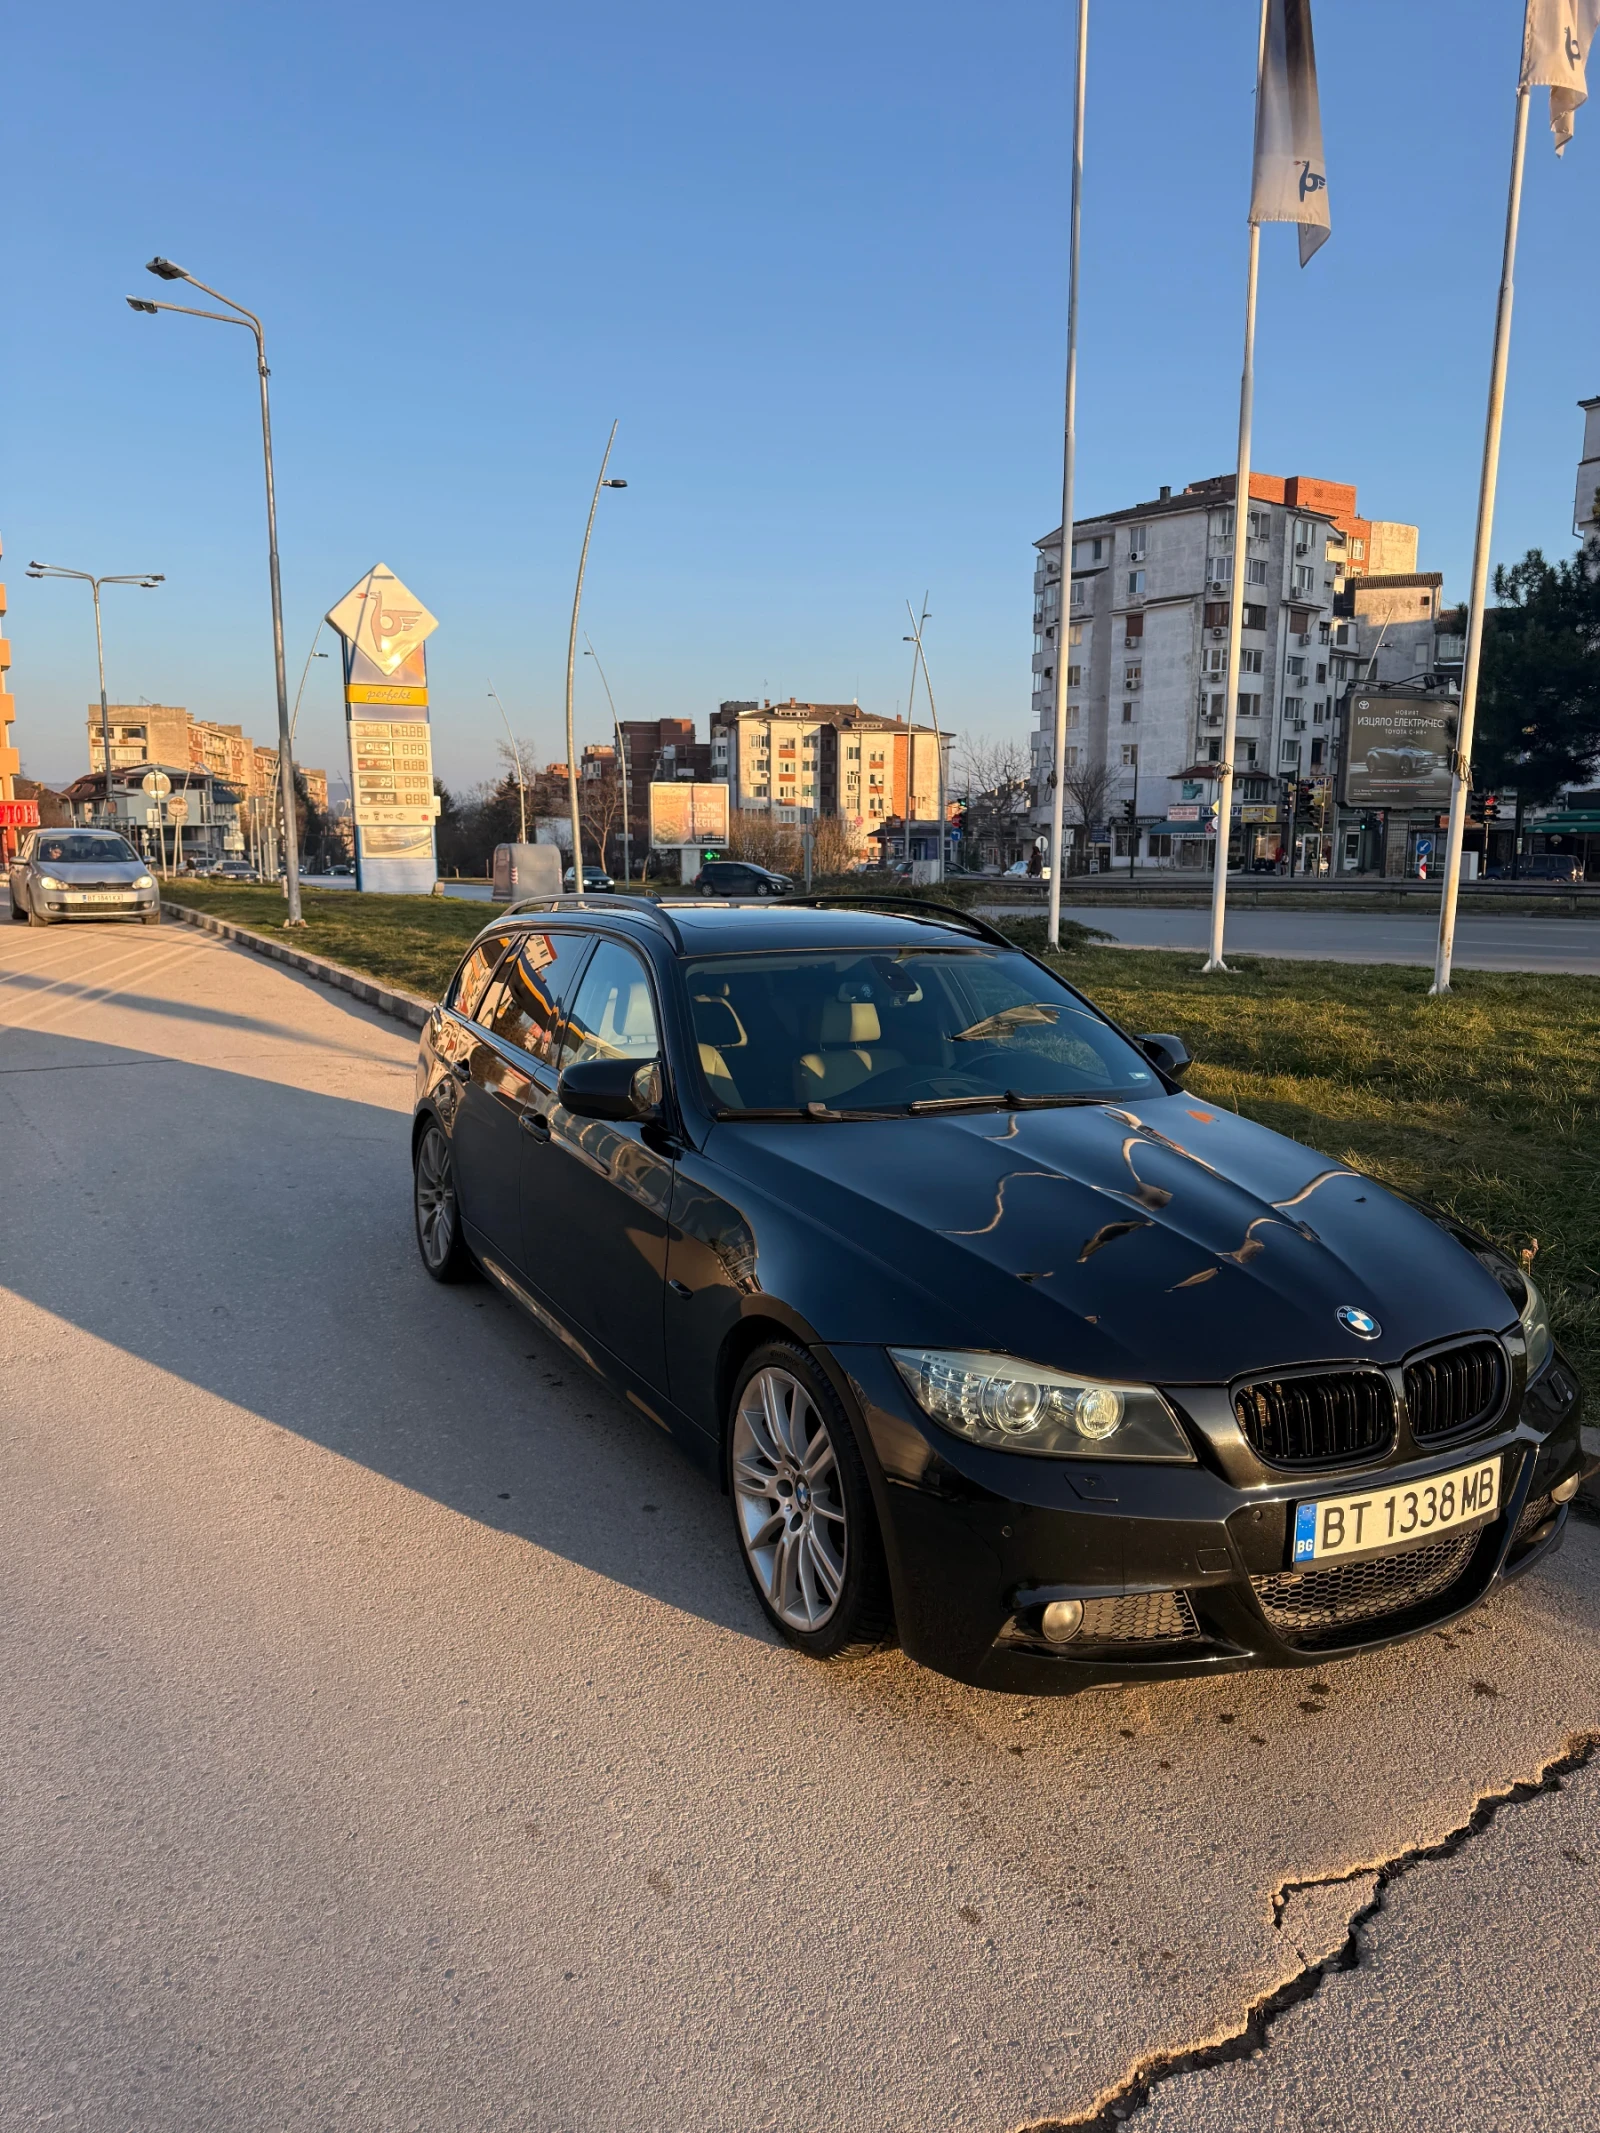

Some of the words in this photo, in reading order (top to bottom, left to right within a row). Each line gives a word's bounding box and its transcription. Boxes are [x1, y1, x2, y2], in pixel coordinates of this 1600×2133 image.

[1357, 716, 1393, 728] ИЗЦЯЛО
[1394, 717, 1446, 728] ЕЛЕКТРИЧЕС
[380, 777, 392, 787] 95
[1321, 1499, 1373, 1551] BT
[1383, 1480, 1456, 1539] 1338
[1460, 1466, 1495, 1517] MB
[1296, 1538, 1314, 1554] BG
